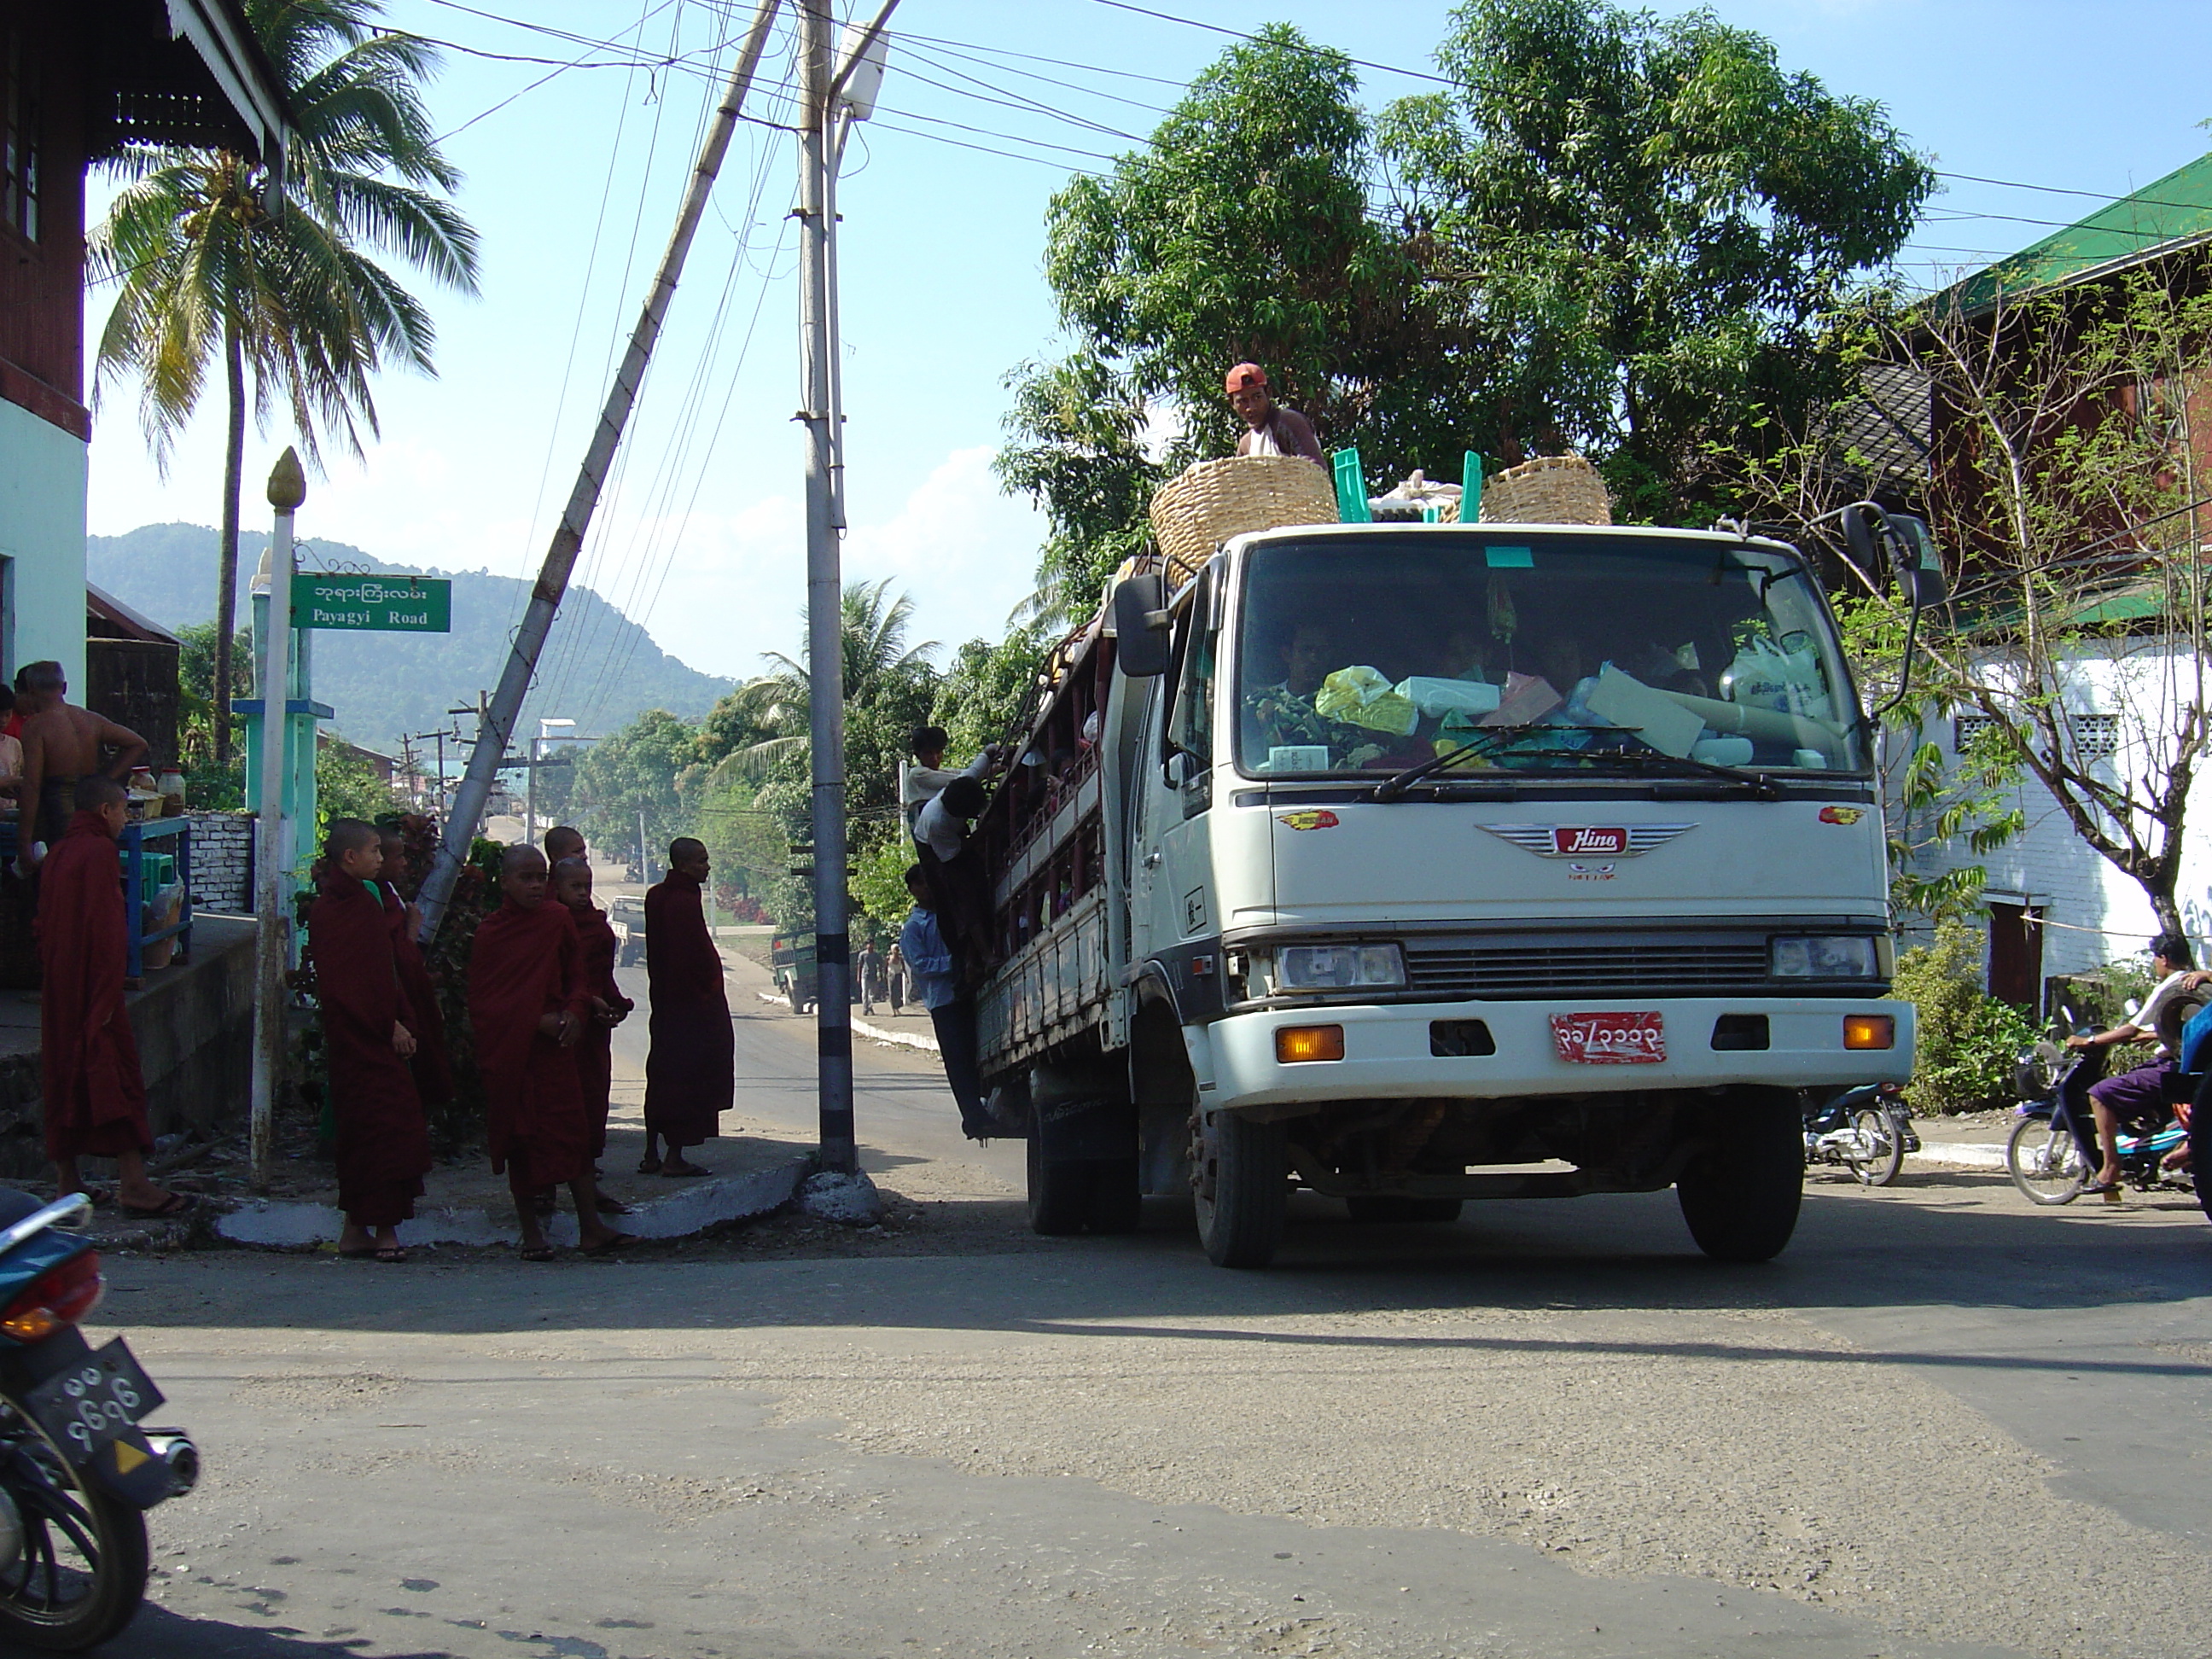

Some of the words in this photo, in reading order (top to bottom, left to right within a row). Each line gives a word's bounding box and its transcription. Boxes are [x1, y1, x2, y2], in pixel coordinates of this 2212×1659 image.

[313, 608, 370, 626] Payagyi
[389, 611, 428, 625] Road
[1567, 829, 1618, 852] Hino
